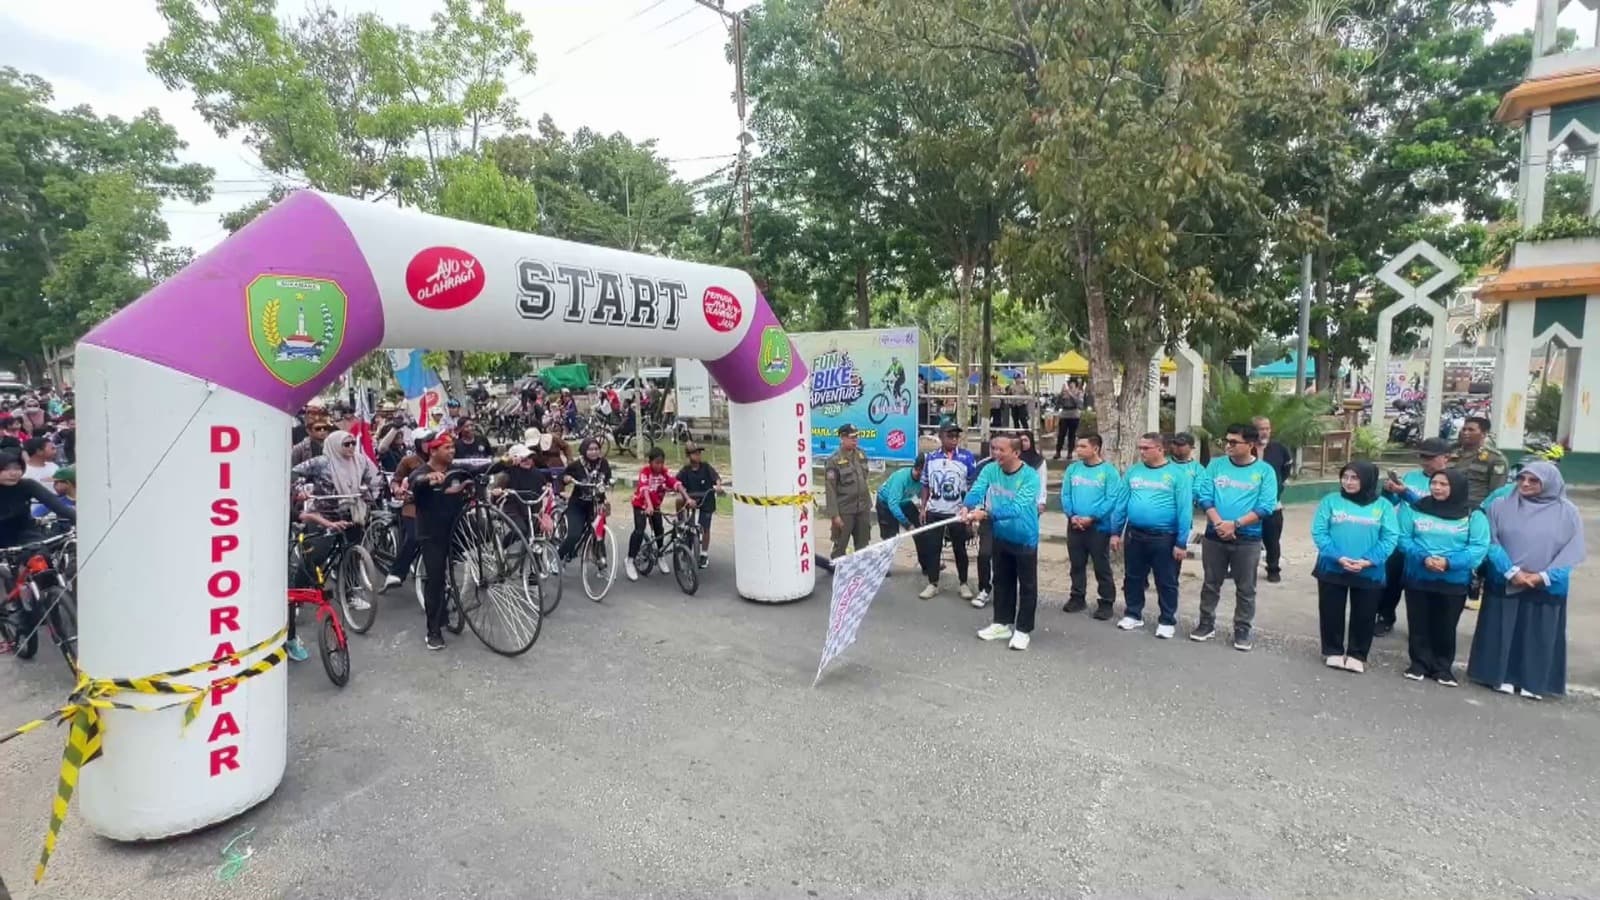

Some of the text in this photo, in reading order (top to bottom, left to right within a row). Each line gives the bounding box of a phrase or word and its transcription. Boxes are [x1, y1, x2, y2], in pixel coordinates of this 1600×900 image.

[426, 257, 460, 282] AYO
[417, 268, 476, 300] OLAHRAGA
[515, 257, 687, 331] START
[813, 353, 839, 371] FUN
[813, 367, 850, 390] BIKE
[795, 403, 810, 573] DISPOAPAR
